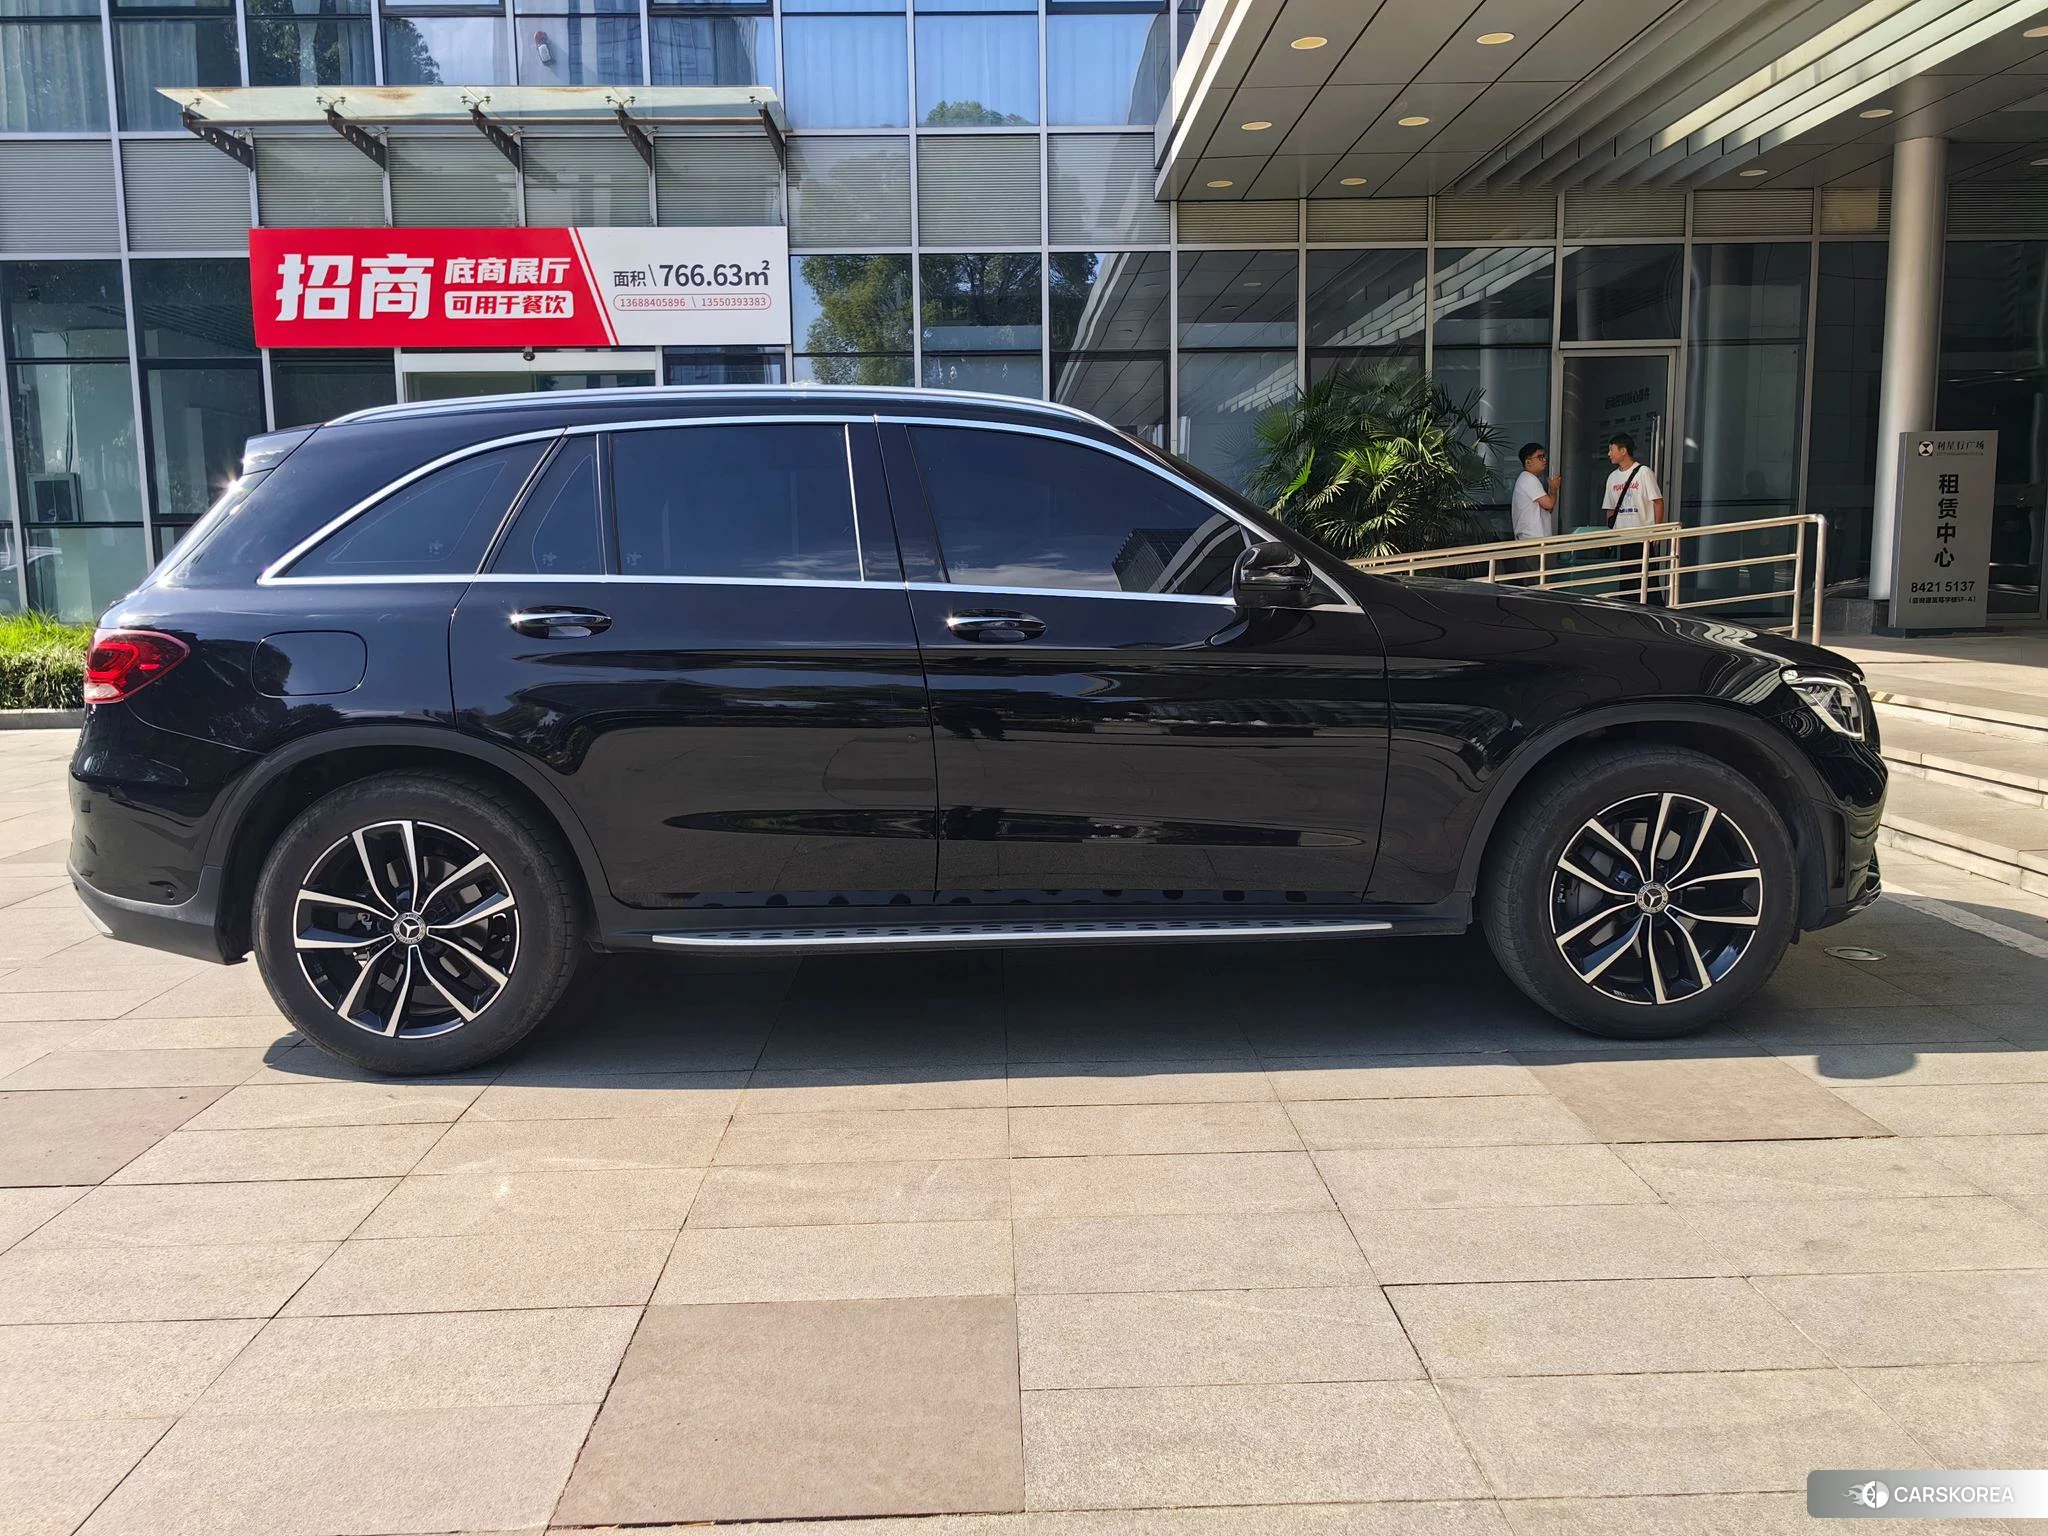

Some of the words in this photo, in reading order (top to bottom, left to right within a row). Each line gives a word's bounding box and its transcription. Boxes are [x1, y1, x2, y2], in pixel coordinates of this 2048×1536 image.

[444, 257, 571, 284] 底商展厅
[275, 253, 435, 321] 招商
[452, 295, 566, 314] 可用于餐饮
[620, 298, 686, 307] 13688405896
[701, 297, 766, 307] 13550393383
[1934, 473, 1960, 568] 租赁中心
[1911, 582, 1941, 593] 8421
[1945, 581, 1976, 592] 5137
